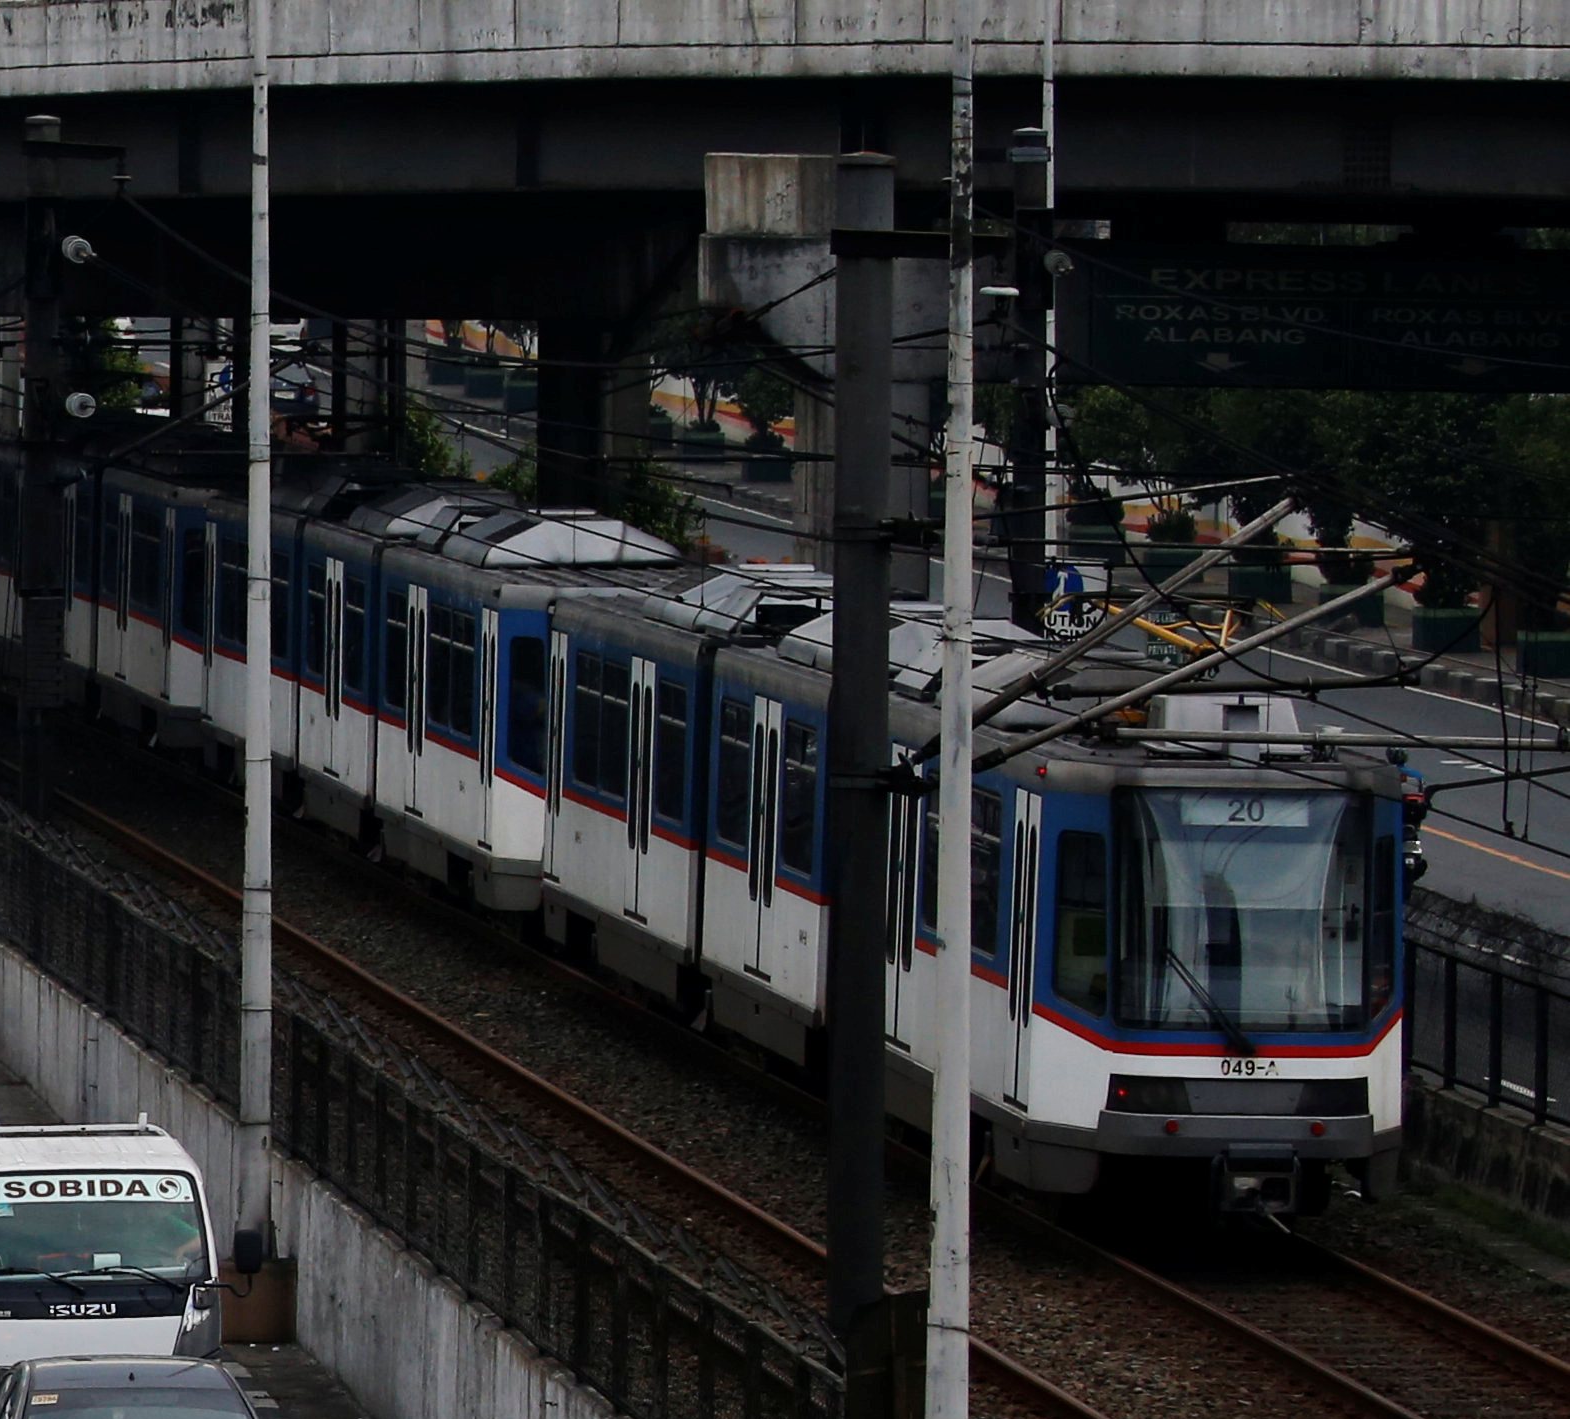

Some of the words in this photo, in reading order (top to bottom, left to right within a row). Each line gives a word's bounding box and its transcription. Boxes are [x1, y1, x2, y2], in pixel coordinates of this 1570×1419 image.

[1149, 268, 1368, 295] EXPRESS
[1382, 271, 1542, 298] LANES
[1114, 304, 1232, 321] ROXAS
[1371, 306, 1488, 326] ROXAS
[1142, 326, 1309, 345] ALABANG
[1402, 329, 1563, 348] ALABANG
[1228, 799, 1265, 822] 20
[1220, 1059, 1280, 1077] 049-A
[3, 1177, 152, 1200] SOBIDA
[48, 1302, 117, 1317] ISUZU
